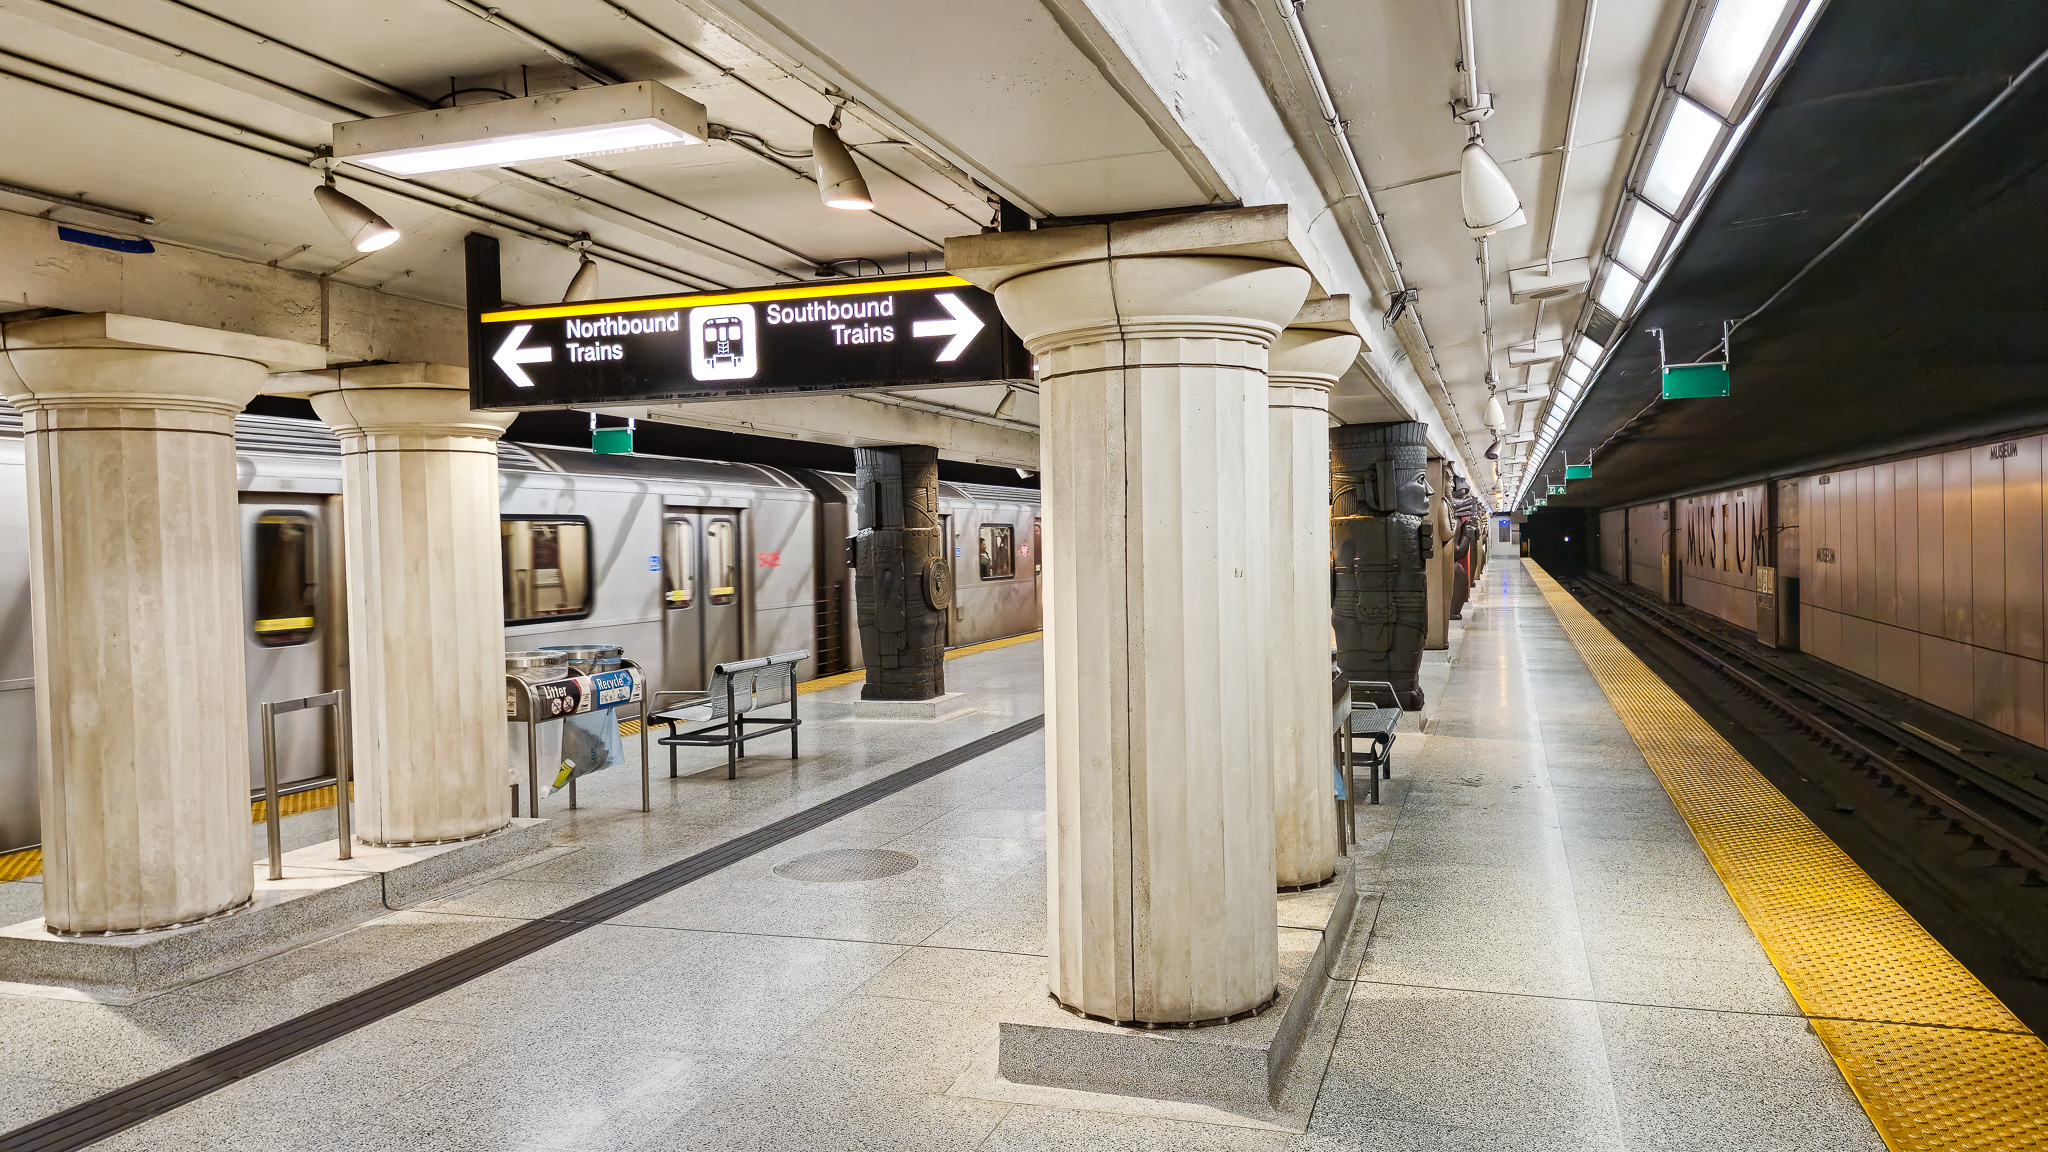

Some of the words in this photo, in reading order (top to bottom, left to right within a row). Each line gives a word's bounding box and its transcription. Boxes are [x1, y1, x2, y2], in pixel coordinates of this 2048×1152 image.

[767, 296, 894, 325] Southbound
[565, 312, 679, 339] Northbound
[831, 323, 895, 346] Trains
[566, 342, 623, 363] Trains
[1990, 442, 2018, 460] MUSEUM
[1687, 502, 1767, 577] MUSEUM
[543, 686, 567, 700] Litter
[596, 674, 624, 691] Recycle
